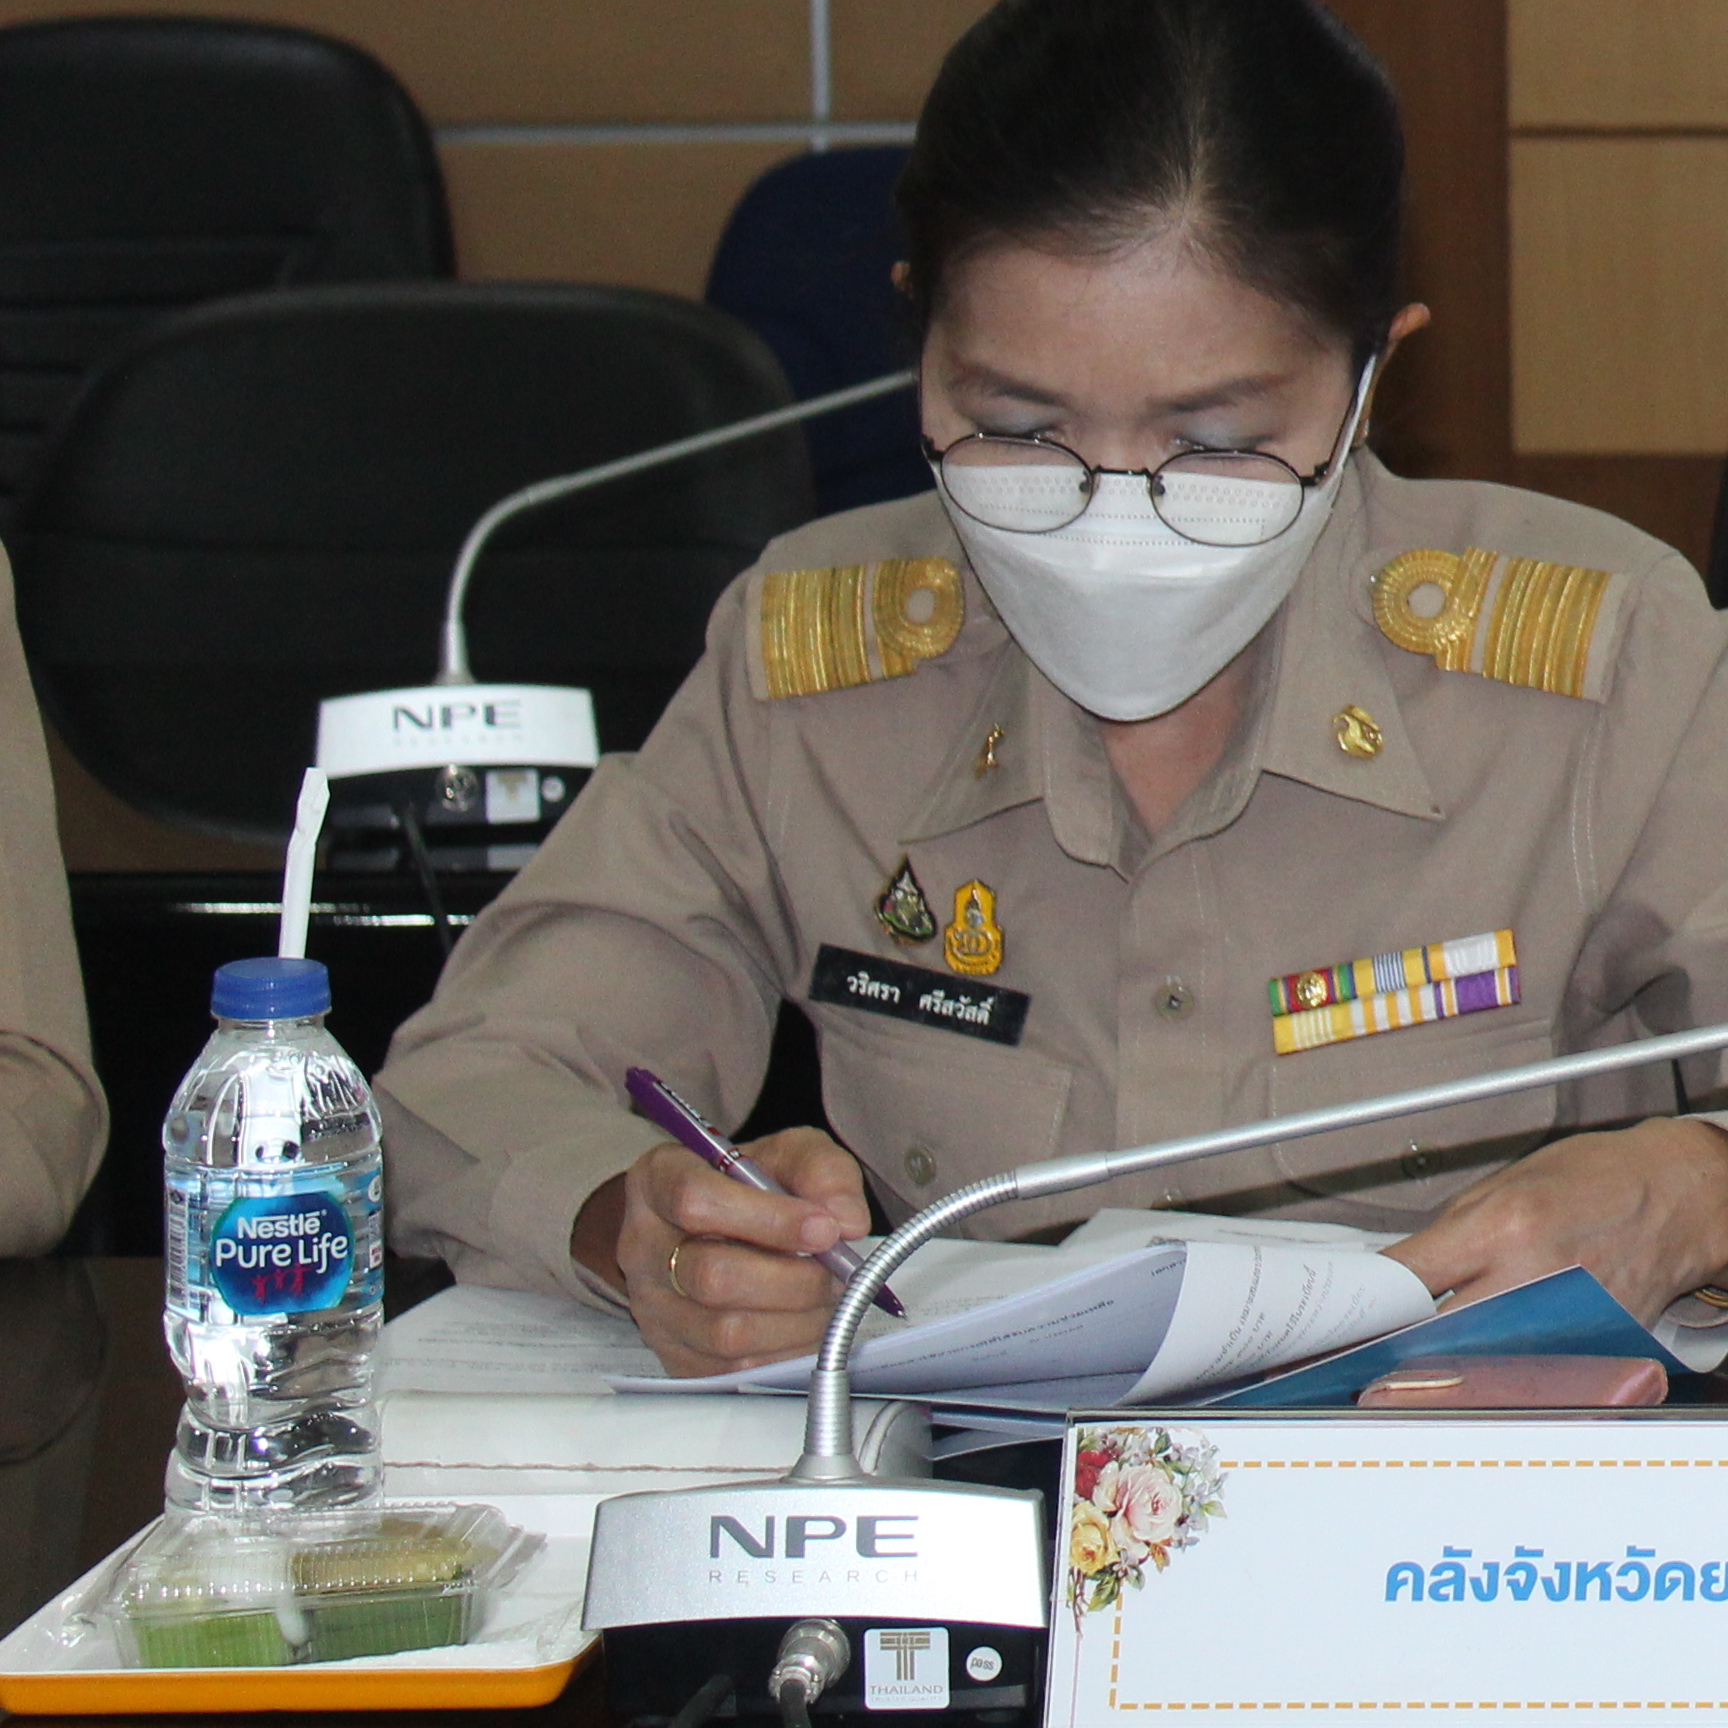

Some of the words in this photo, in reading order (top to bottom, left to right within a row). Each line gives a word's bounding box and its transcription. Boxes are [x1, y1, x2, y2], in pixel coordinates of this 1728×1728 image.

[393, 700, 521, 731] NPE
[215, 1238, 291, 1269] Pure
[298, 1233, 348, 1274] Life
[709, 1514, 920, 1560] NPE
[708, 1569, 918, 1585] RESEARCH
[970, 1657, 996, 1671] pass
[869, 1684, 944, 1696] THAILAND
